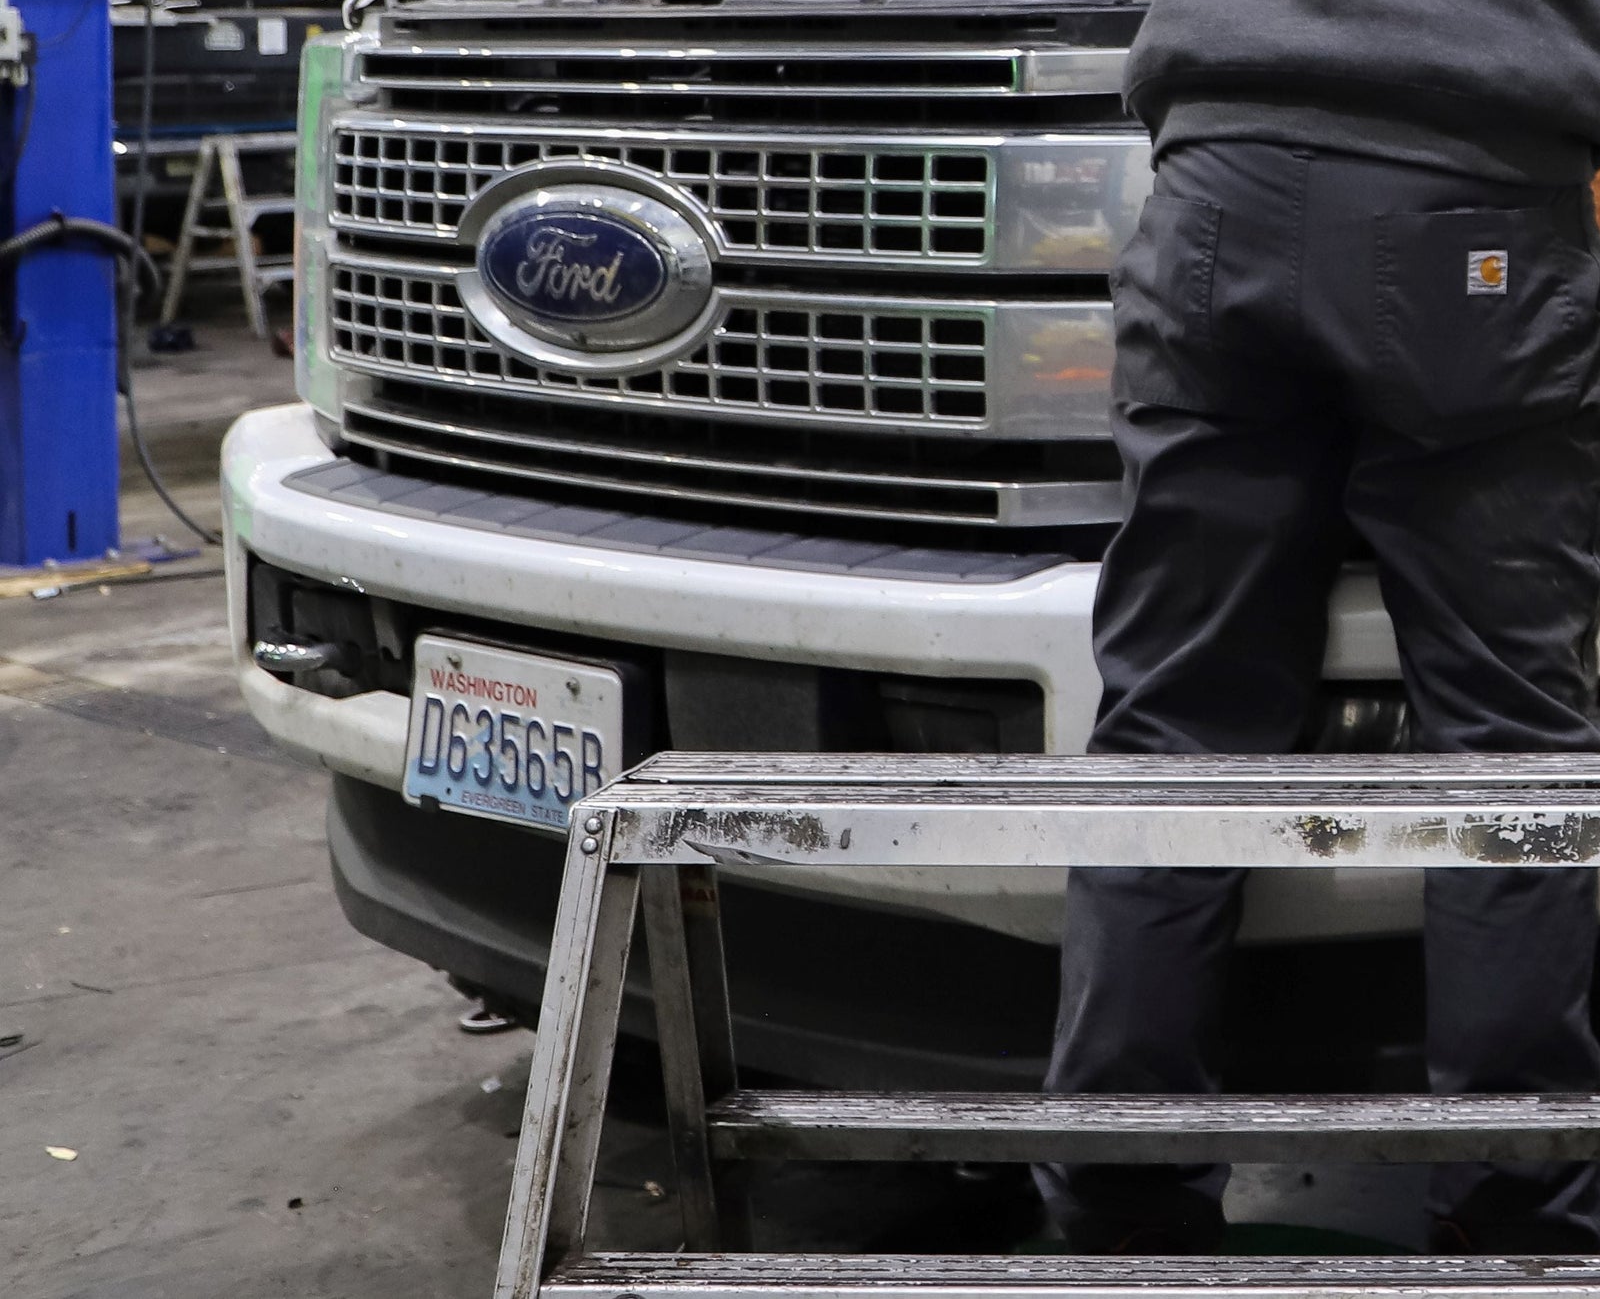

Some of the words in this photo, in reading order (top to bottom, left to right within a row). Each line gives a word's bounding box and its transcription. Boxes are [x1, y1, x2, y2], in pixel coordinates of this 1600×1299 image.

[516, 225, 625, 304] Ford
[430, 668, 537, 707] WASHINGTON
[460, 791, 527, 816] EVERGREEN
[531, 806, 564, 824] STATE
